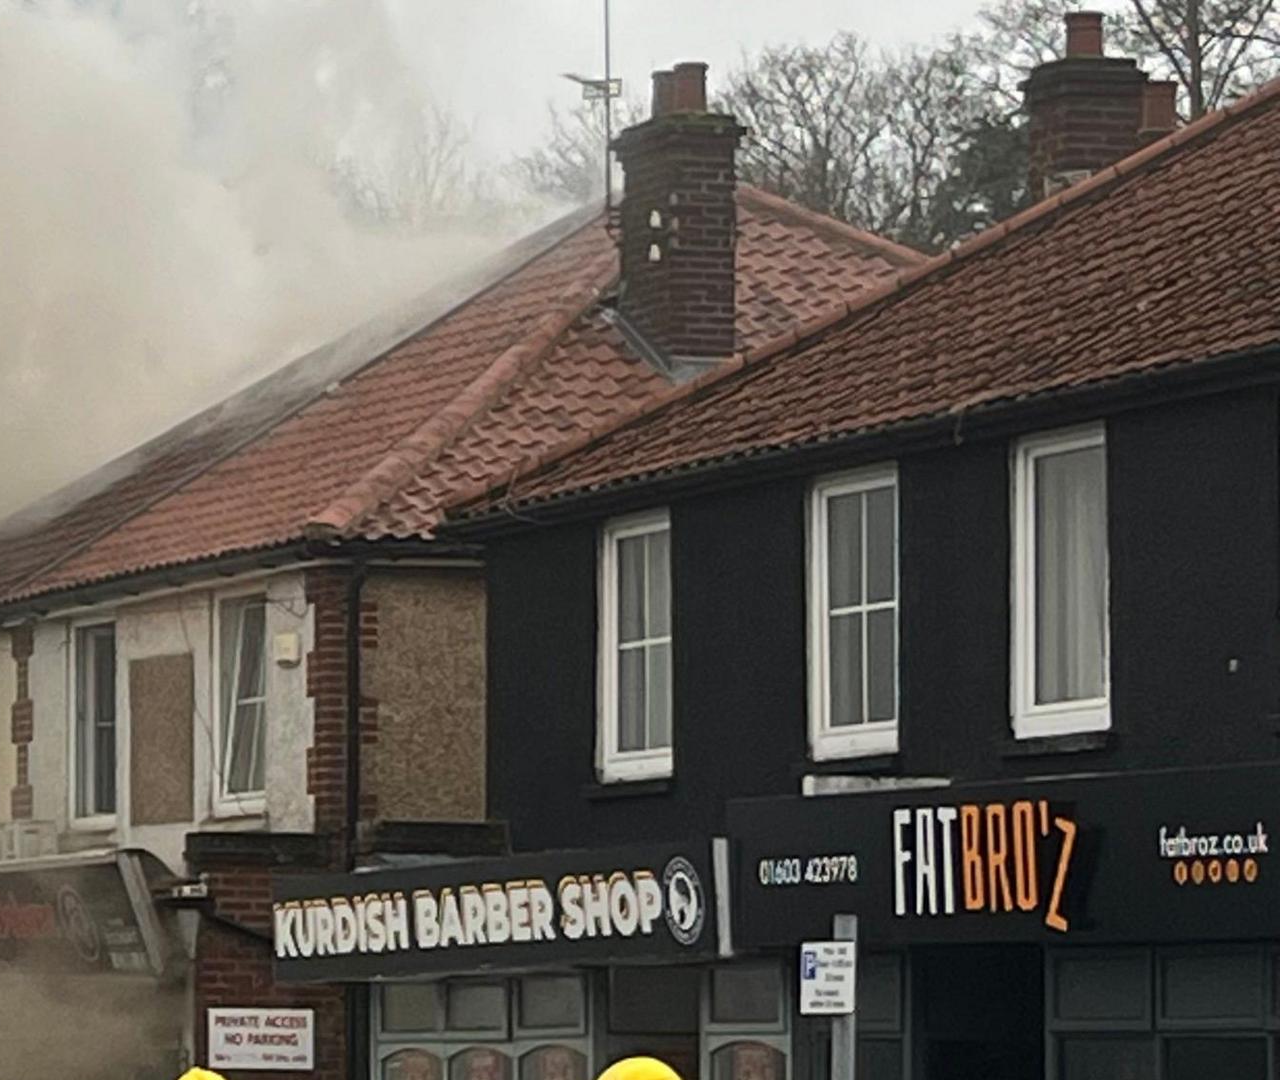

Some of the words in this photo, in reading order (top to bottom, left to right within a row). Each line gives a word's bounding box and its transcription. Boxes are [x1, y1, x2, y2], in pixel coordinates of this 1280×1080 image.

[1159, 821, 1269, 857] fatbroz.co.uk
[759, 858, 801, 884] 01603
[804, 855, 857, 882] 423978
[274, 892, 409, 958] KURDISH
[414, 880, 556, 948] BARBER
[558, 871, 662, 938] SHOP
[215, 1015, 260, 1029] PRIVATE
[265, 1015, 307, 1029] ACCESS
[224, 1033, 243, 1046] NO
[248, 1033, 299, 1046] PARKING
